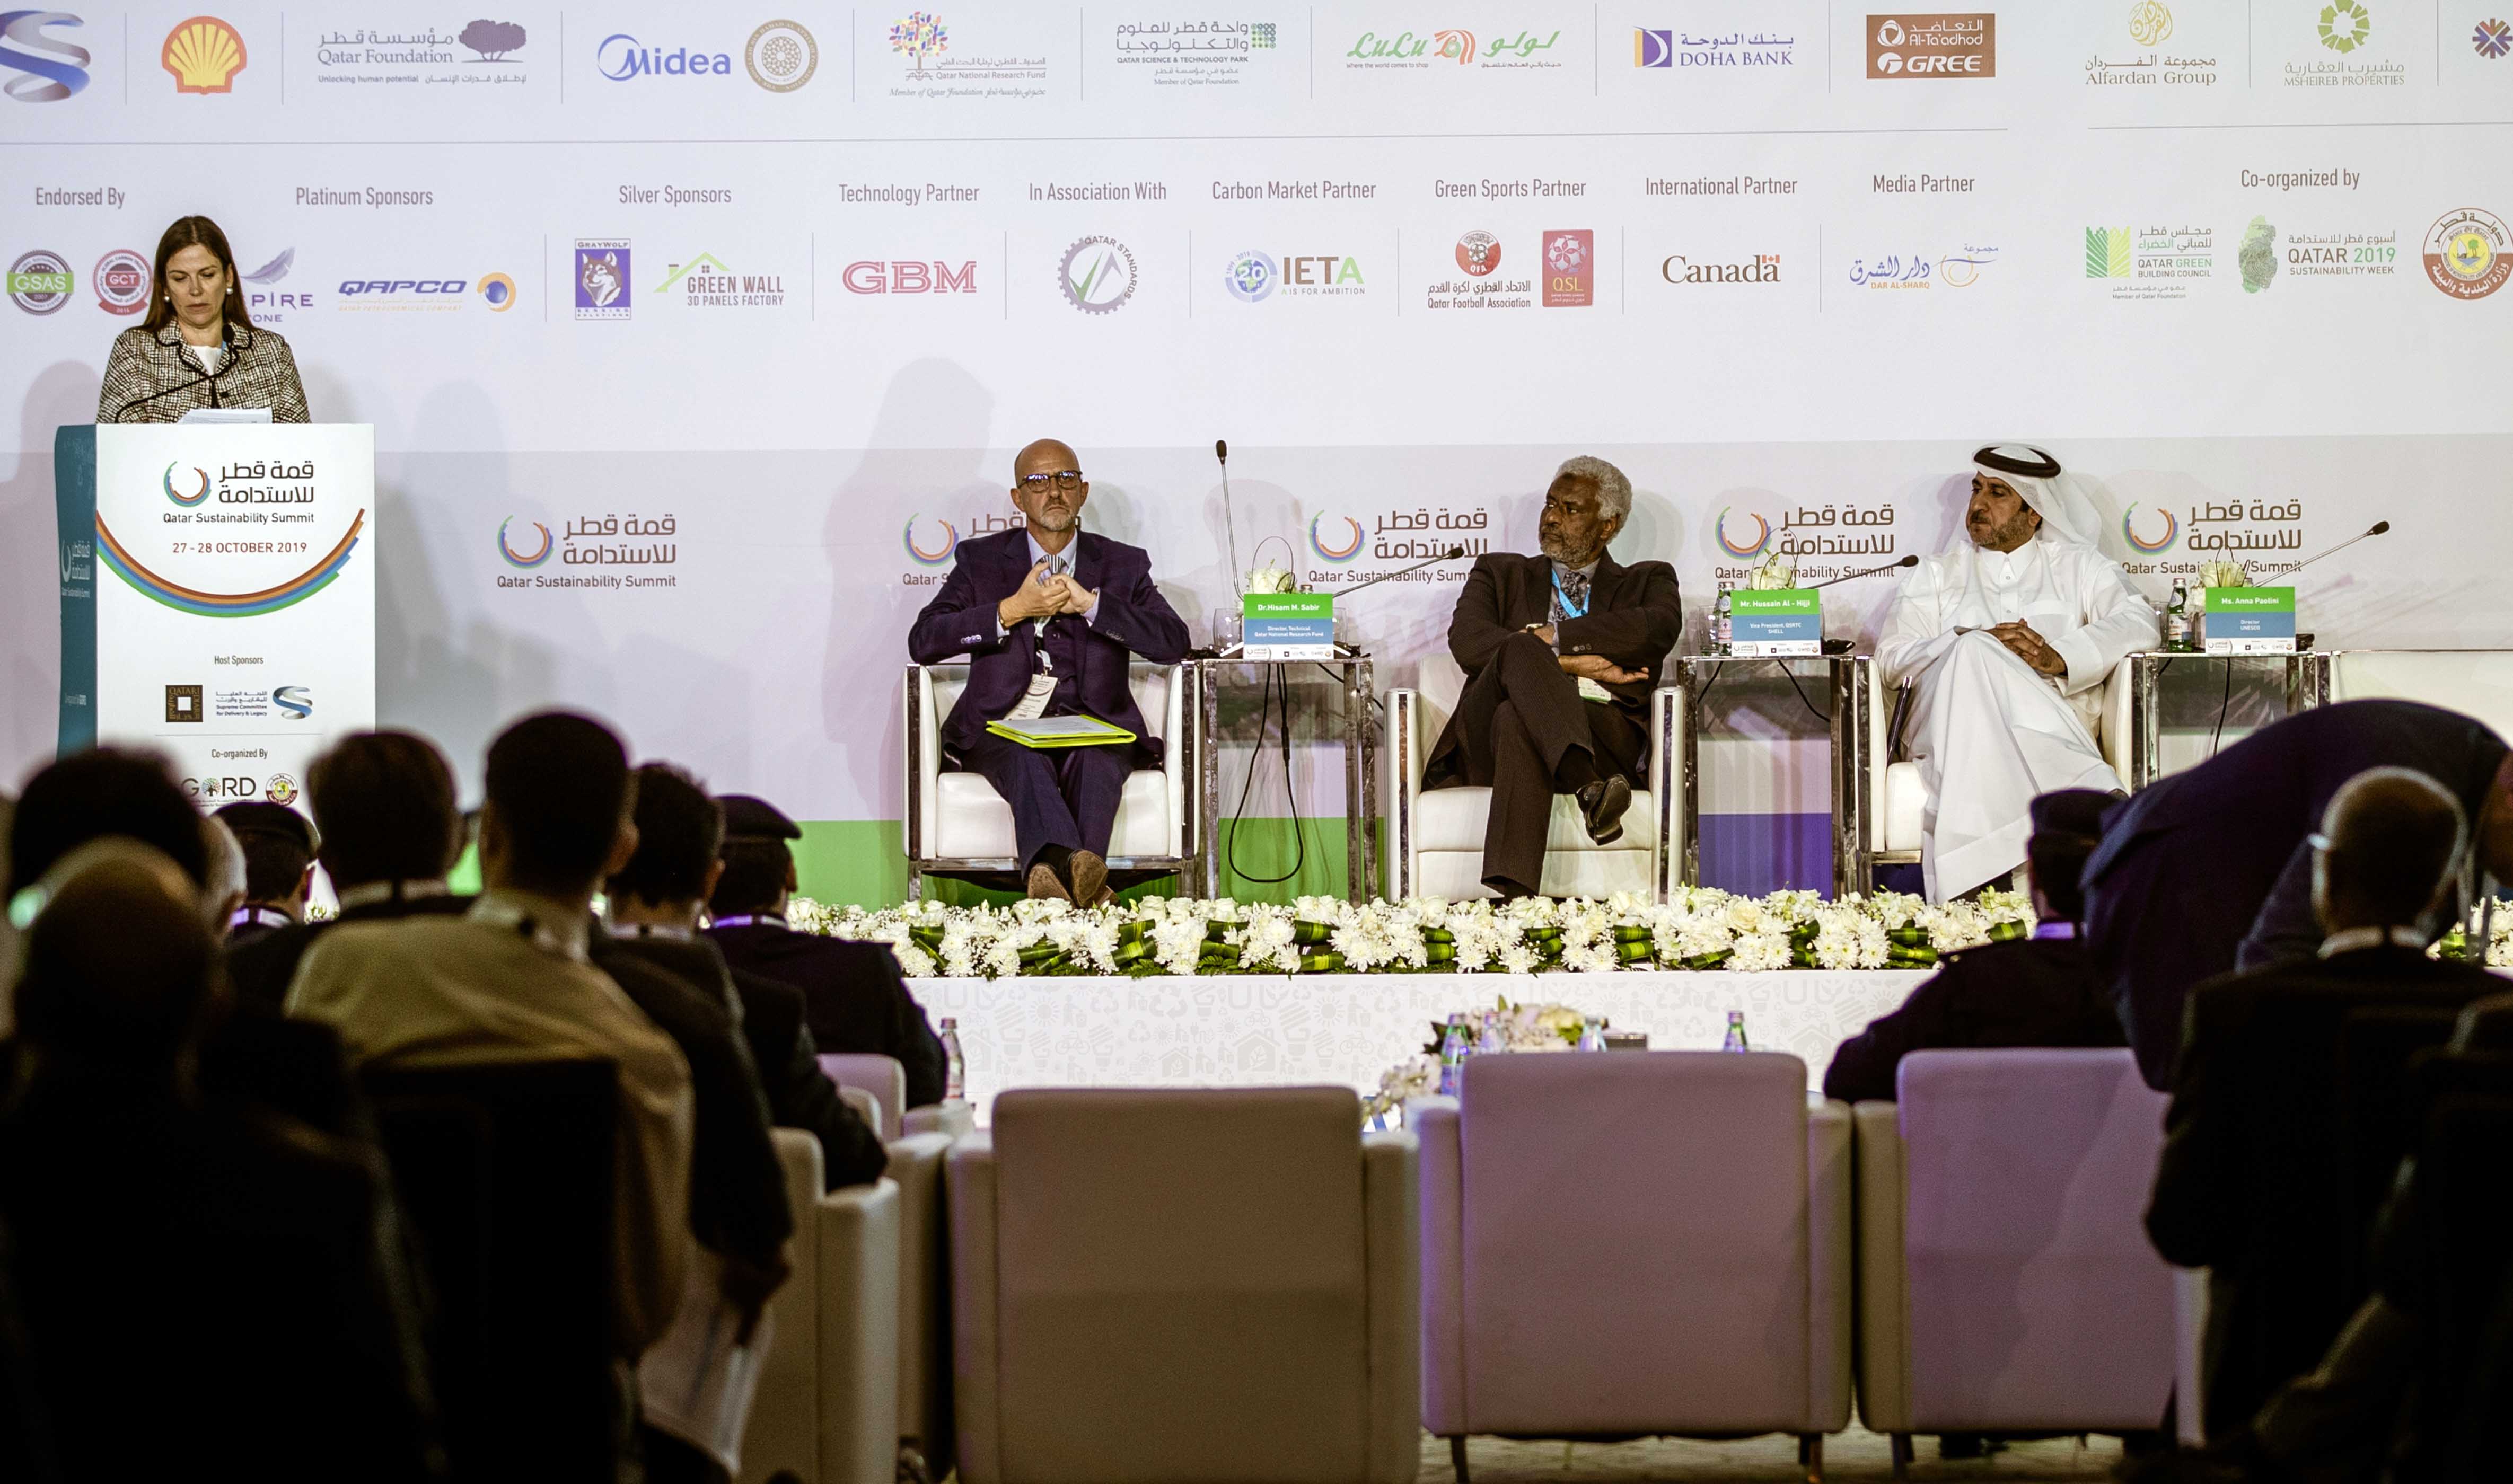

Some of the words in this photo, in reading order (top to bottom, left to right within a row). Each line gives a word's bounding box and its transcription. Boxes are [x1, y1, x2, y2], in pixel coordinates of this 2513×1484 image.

[1117, 22, 1171, 37] للعلوم
[1173, 22, 1207, 35] قطر
[1211, 21, 1249, 35] واحة
[319, 30, 364, 48] قطر
[368, 27, 453, 47] مؤسسة
[1481, 30, 1561, 57] لولو
[1681, 32, 1744, 50] الدوحة
[1748, 32, 1794, 49] بنك
[1117, 38, 1249, 54] والتكنولوجيا
[318, 49, 361, 66] Qatar
[366, 49, 453, 63] Foundation
[1680, 52, 1735, 66] DOHA
[1743, 51, 1794, 66] BANK
[1907, 55, 1982, 72] GREE
[2085, 55, 2157, 70] الفردان
[2164, 57, 2216, 71] مجموعة
[318, 75, 355, 84] Unlocking
[386, 75, 419, 84] potential
[2086, 71, 2157, 85] Alfardan
[2164, 71, 2216, 86] Group
[2284, 76, 2339, 86] MSHEIREB
[2342, 75, 2404, 85] PROPERTIES
[1646, 177, 1739, 195] International
[1744, 176, 1797, 194] Partner
[1873, 175, 1916, 192] Media
[1921, 174, 1974, 192] Partner
[2241, 169, 2338, 191] Co-organized
[2343, 169, 2360, 190] by
[36, 187, 102, 205] Endorsed
[108, 187, 125, 209] By
[296, 187, 361, 205] Platinum
[366, 187, 433, 208] Sponsors
[619, 186, 660, 204] Silver
[664, 185, 732, 207] Sponsors
[839, 184, 921, 205] Technology
[926, 184, 979, 201] Partner
[1029, 183, 1042, 201] In
[1047, 183, 1130, 201] Association
[1134, 182, 1167, 200] With
[1212, 182, 1263, 199] Carbon
[1268, 181, 1318, 199] Market
[1323, 181, 1376, 198] Partner
[1435, 180, 1477, 197] Green
[1481, 179, 1528, 201] Sports
[1533, 179, 1586, 196] Partner
[2139, 226, 2166, 238] قطر
[2171, 226, 2211, 239] مجلس
[2288, 234, 2342, 244] للاستدامة
[2344, 234, 2363, 245] قطر
[2138, 259, 2173, 269] QATAR
[2176, 258, 2212, 268] GREEN
[2288, 249, 2347, 263] QATAR
[2353, 248, 2395, 263] 2019
[1284, 256, 1364, 285] IETA
[1663, 255, 1781, 283] Canada
[1849, 255, 1899, 285] الشرق
[2290, 267, 2365, 276] SUSTAINABILITY
[2367, 266, 2395, 275] WEEK
[15, 275, 66, 291] GSAS
[110, 275, 136, 285] GCT
[688, 276, 737, 293] GREEN
[743, 276, 784, 293] WALL
[842, 261, 977, 294] GBM
[1552, 277, 1584, 292] QSL
[339, 281, 467, 296] QAPCO
[1428, 281, 1451, 295] القدم
[1453, 281, 1470, 294] لكرة
[1473, 281, 1502, 294] القطري
[1505, 280, 1531, 292] الاتحاد
[688, 296, 700, 306] 3D
[703, 296, 739, 306] PANELS
[742, 295, 784, 305] FACTORY
[1428, 298, 1450, 309] Qatar
[1453, 298, 1484, 308] Football
[1487, 297, 1531, 308] Association
[219, 461, 266, 483] قطر
[271, 460, 314, 479] قمة
[219, 484, 314, 504] للاستدامة
[1842, 504, 1894, 526] قمة
[2188, 499, 2243, 526] قطر
[2250, 499, 2301, 520] قمة
[163, 513, 192, 524] Qatar
[196, 513, 268, 524] Sustainability
[271, 512, 314, 523] Summit
[624, 514, 676, 535] قمة
[1374, 508, 1429, 534] قطر
[1436, 508, 1488, 529] قمة
[1781, 505, 1835, 531] قطر
[563, 514, 618, 540] قطر
[172, 543, 187, 553] 27
[198, 543, 212, 553] 28
[216, 542, 273, 553] OCTOBER
[278, 542, 307, 553] 2019
[1781, 533, 1894, 555] للاستدامة
[2188, 529, 2301, 550] للاستدامة
[563, 542, 676, 564] للاستدامة
[1715, 567, 1749, 578] Qatar
[1843, 566, 1894, 578] Summit
[2251, 560, 2302, 572] Summit
[497, 576, 532, 588] Qatar
[536, 575, 621, 589] Sustainability
[625, 575, 676, 587] Summit
[903, 573, 937, 585] Qatar
[1308, 571, 1343, 582] Qatar
[1347, 570, 1433, 584] Sustainability
[214, 656, 230, 665] Host
[232, 655, 264, 666] Sponsors
[212, 749, 258, 760] Co-organized
[259, 749, 268, 759] By
